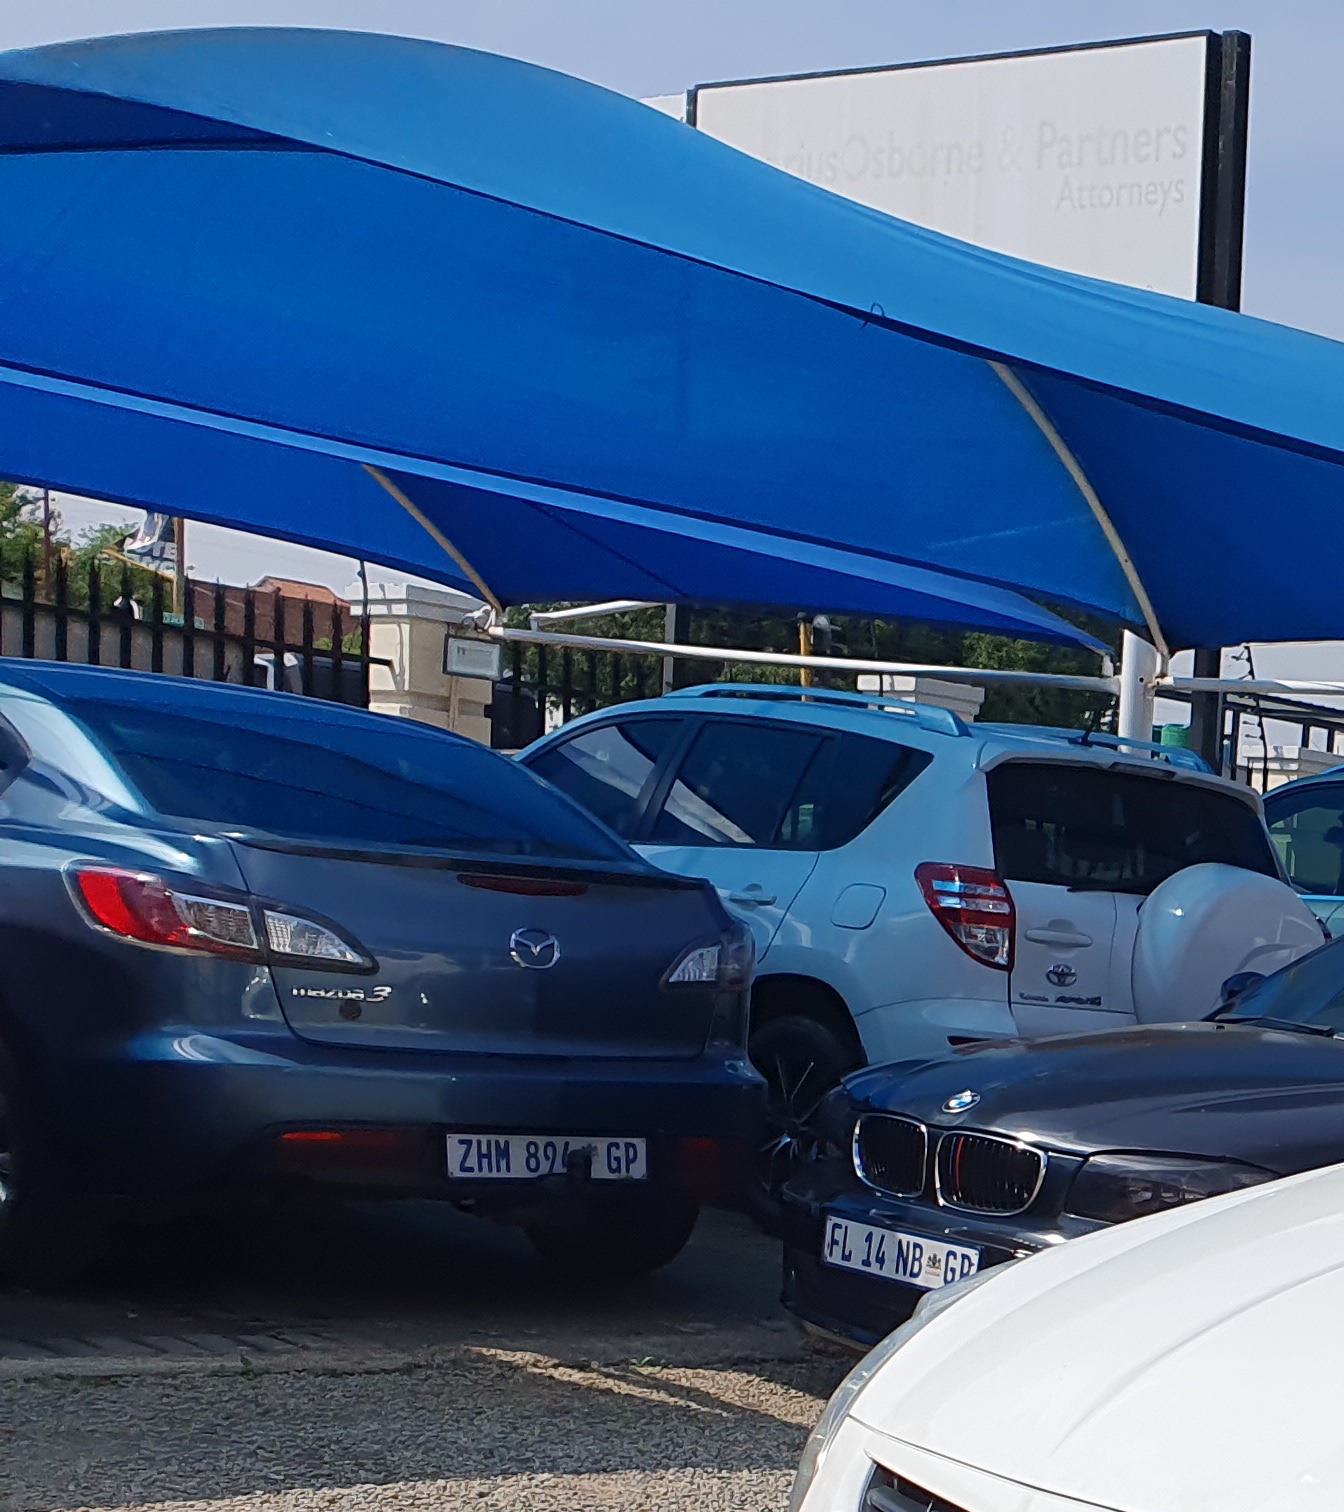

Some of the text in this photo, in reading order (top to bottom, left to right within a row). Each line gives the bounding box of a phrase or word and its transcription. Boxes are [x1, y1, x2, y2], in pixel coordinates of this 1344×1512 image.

[997, 125, 1024, 173] &
[1036, 119, 1189, 172] Partners
[1055, 174, 1186, 216] Attorneys
[457, 1138, 511, 1174] ZHM
[606, 1141, 639, 1175] GP
[828, 1222, 853, 1263] FL
[861, 1230, 886, 1271] 14
[894, 1238, 924, 1279] NB
